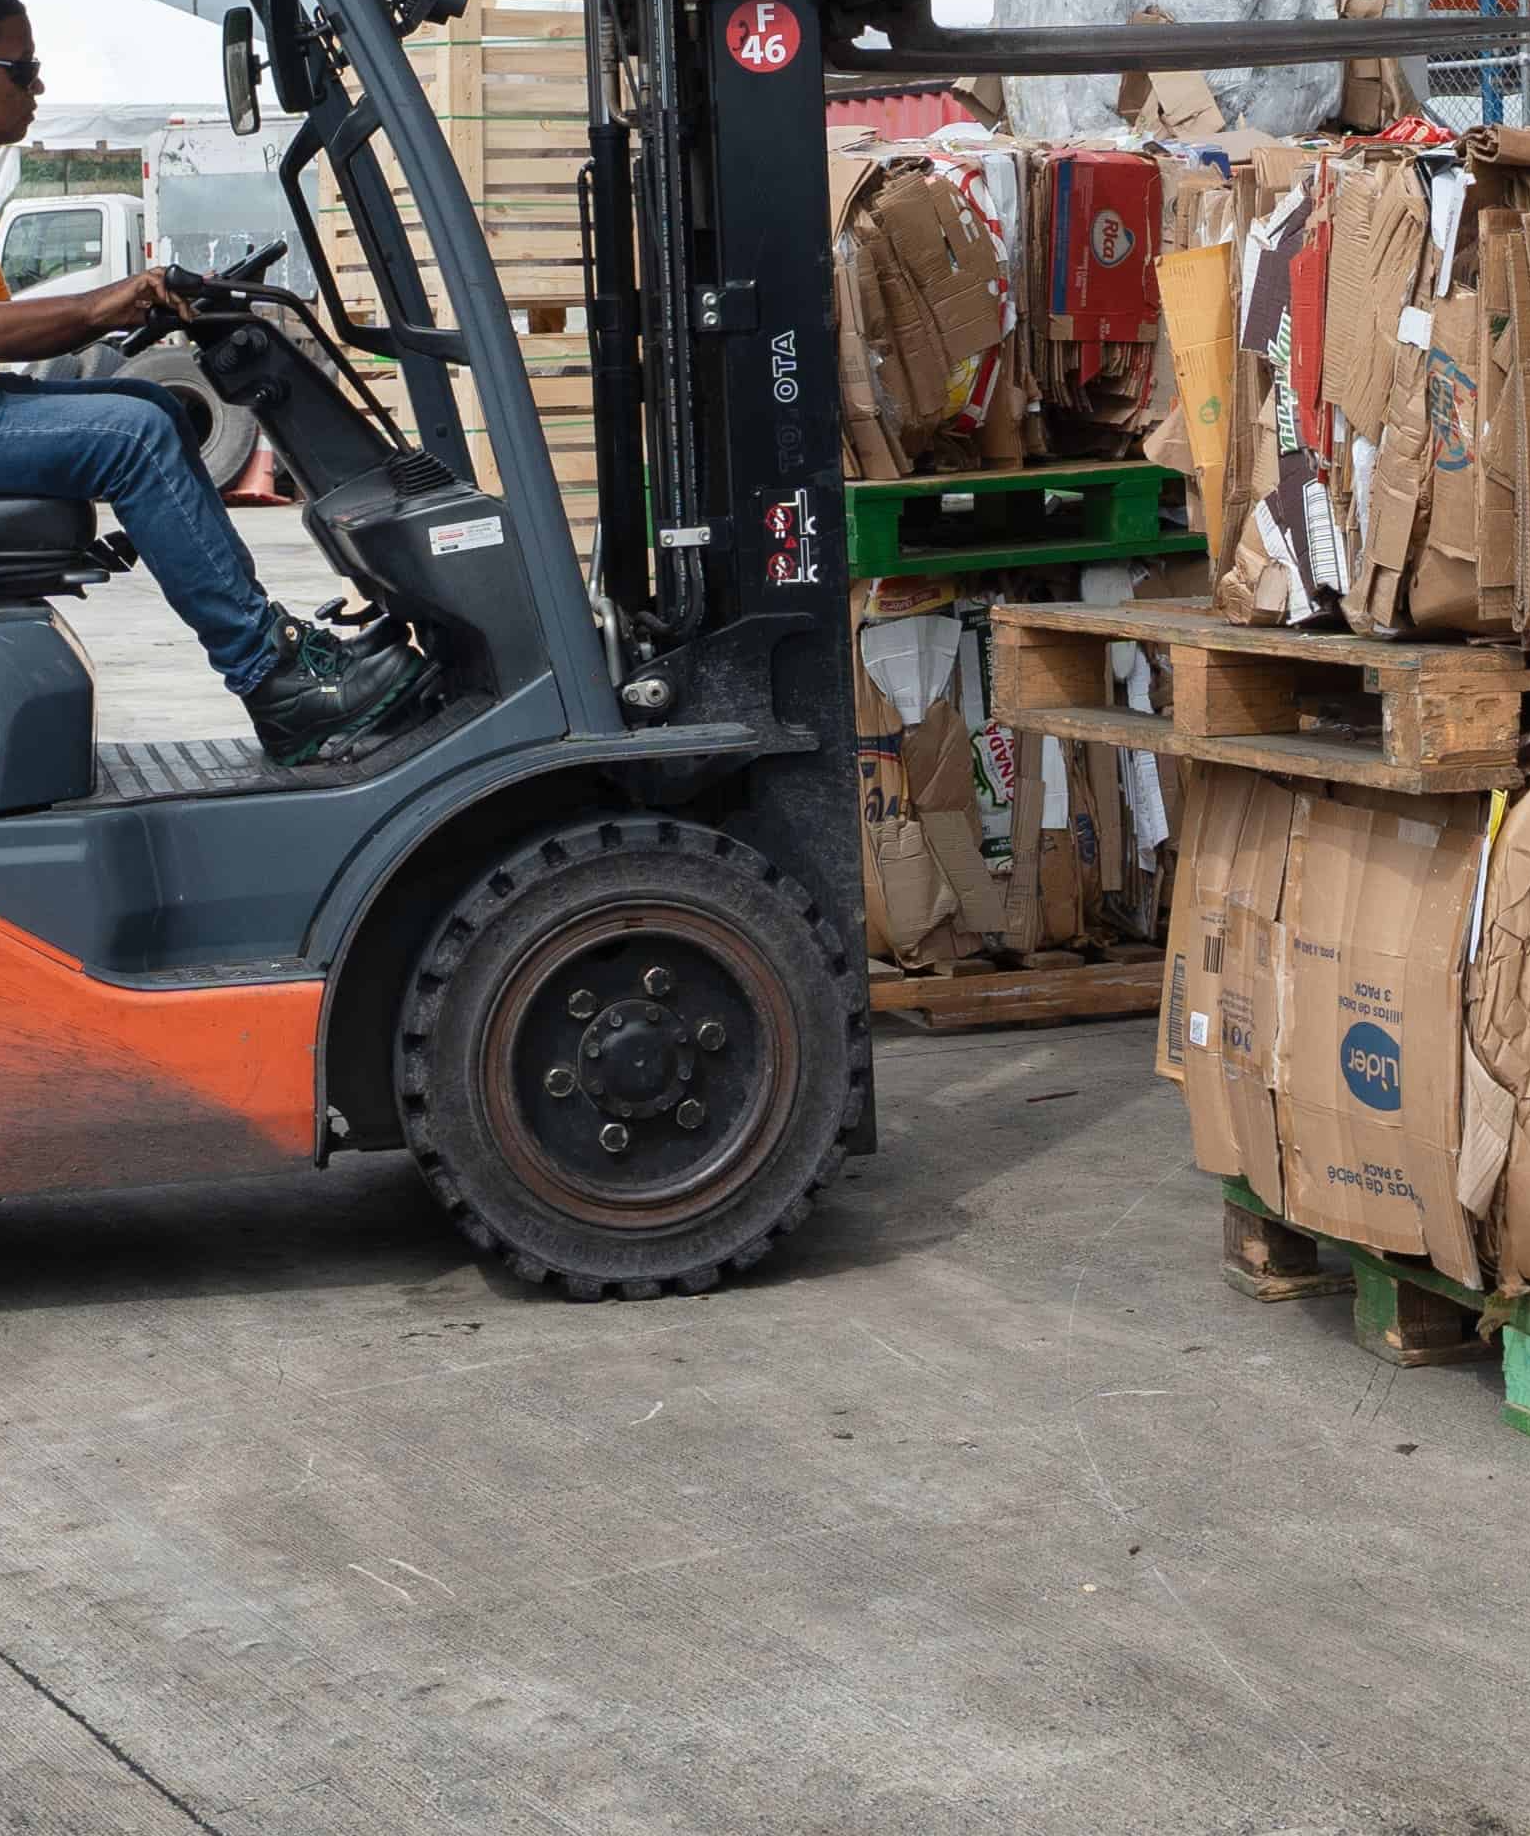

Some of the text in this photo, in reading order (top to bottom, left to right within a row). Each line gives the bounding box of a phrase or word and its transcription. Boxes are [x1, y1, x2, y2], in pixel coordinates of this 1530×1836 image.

[756, 3, 775, 33] F
[1102, 218, 1119, 261] Rica
[1365, 1177, 1384, 1196] de
